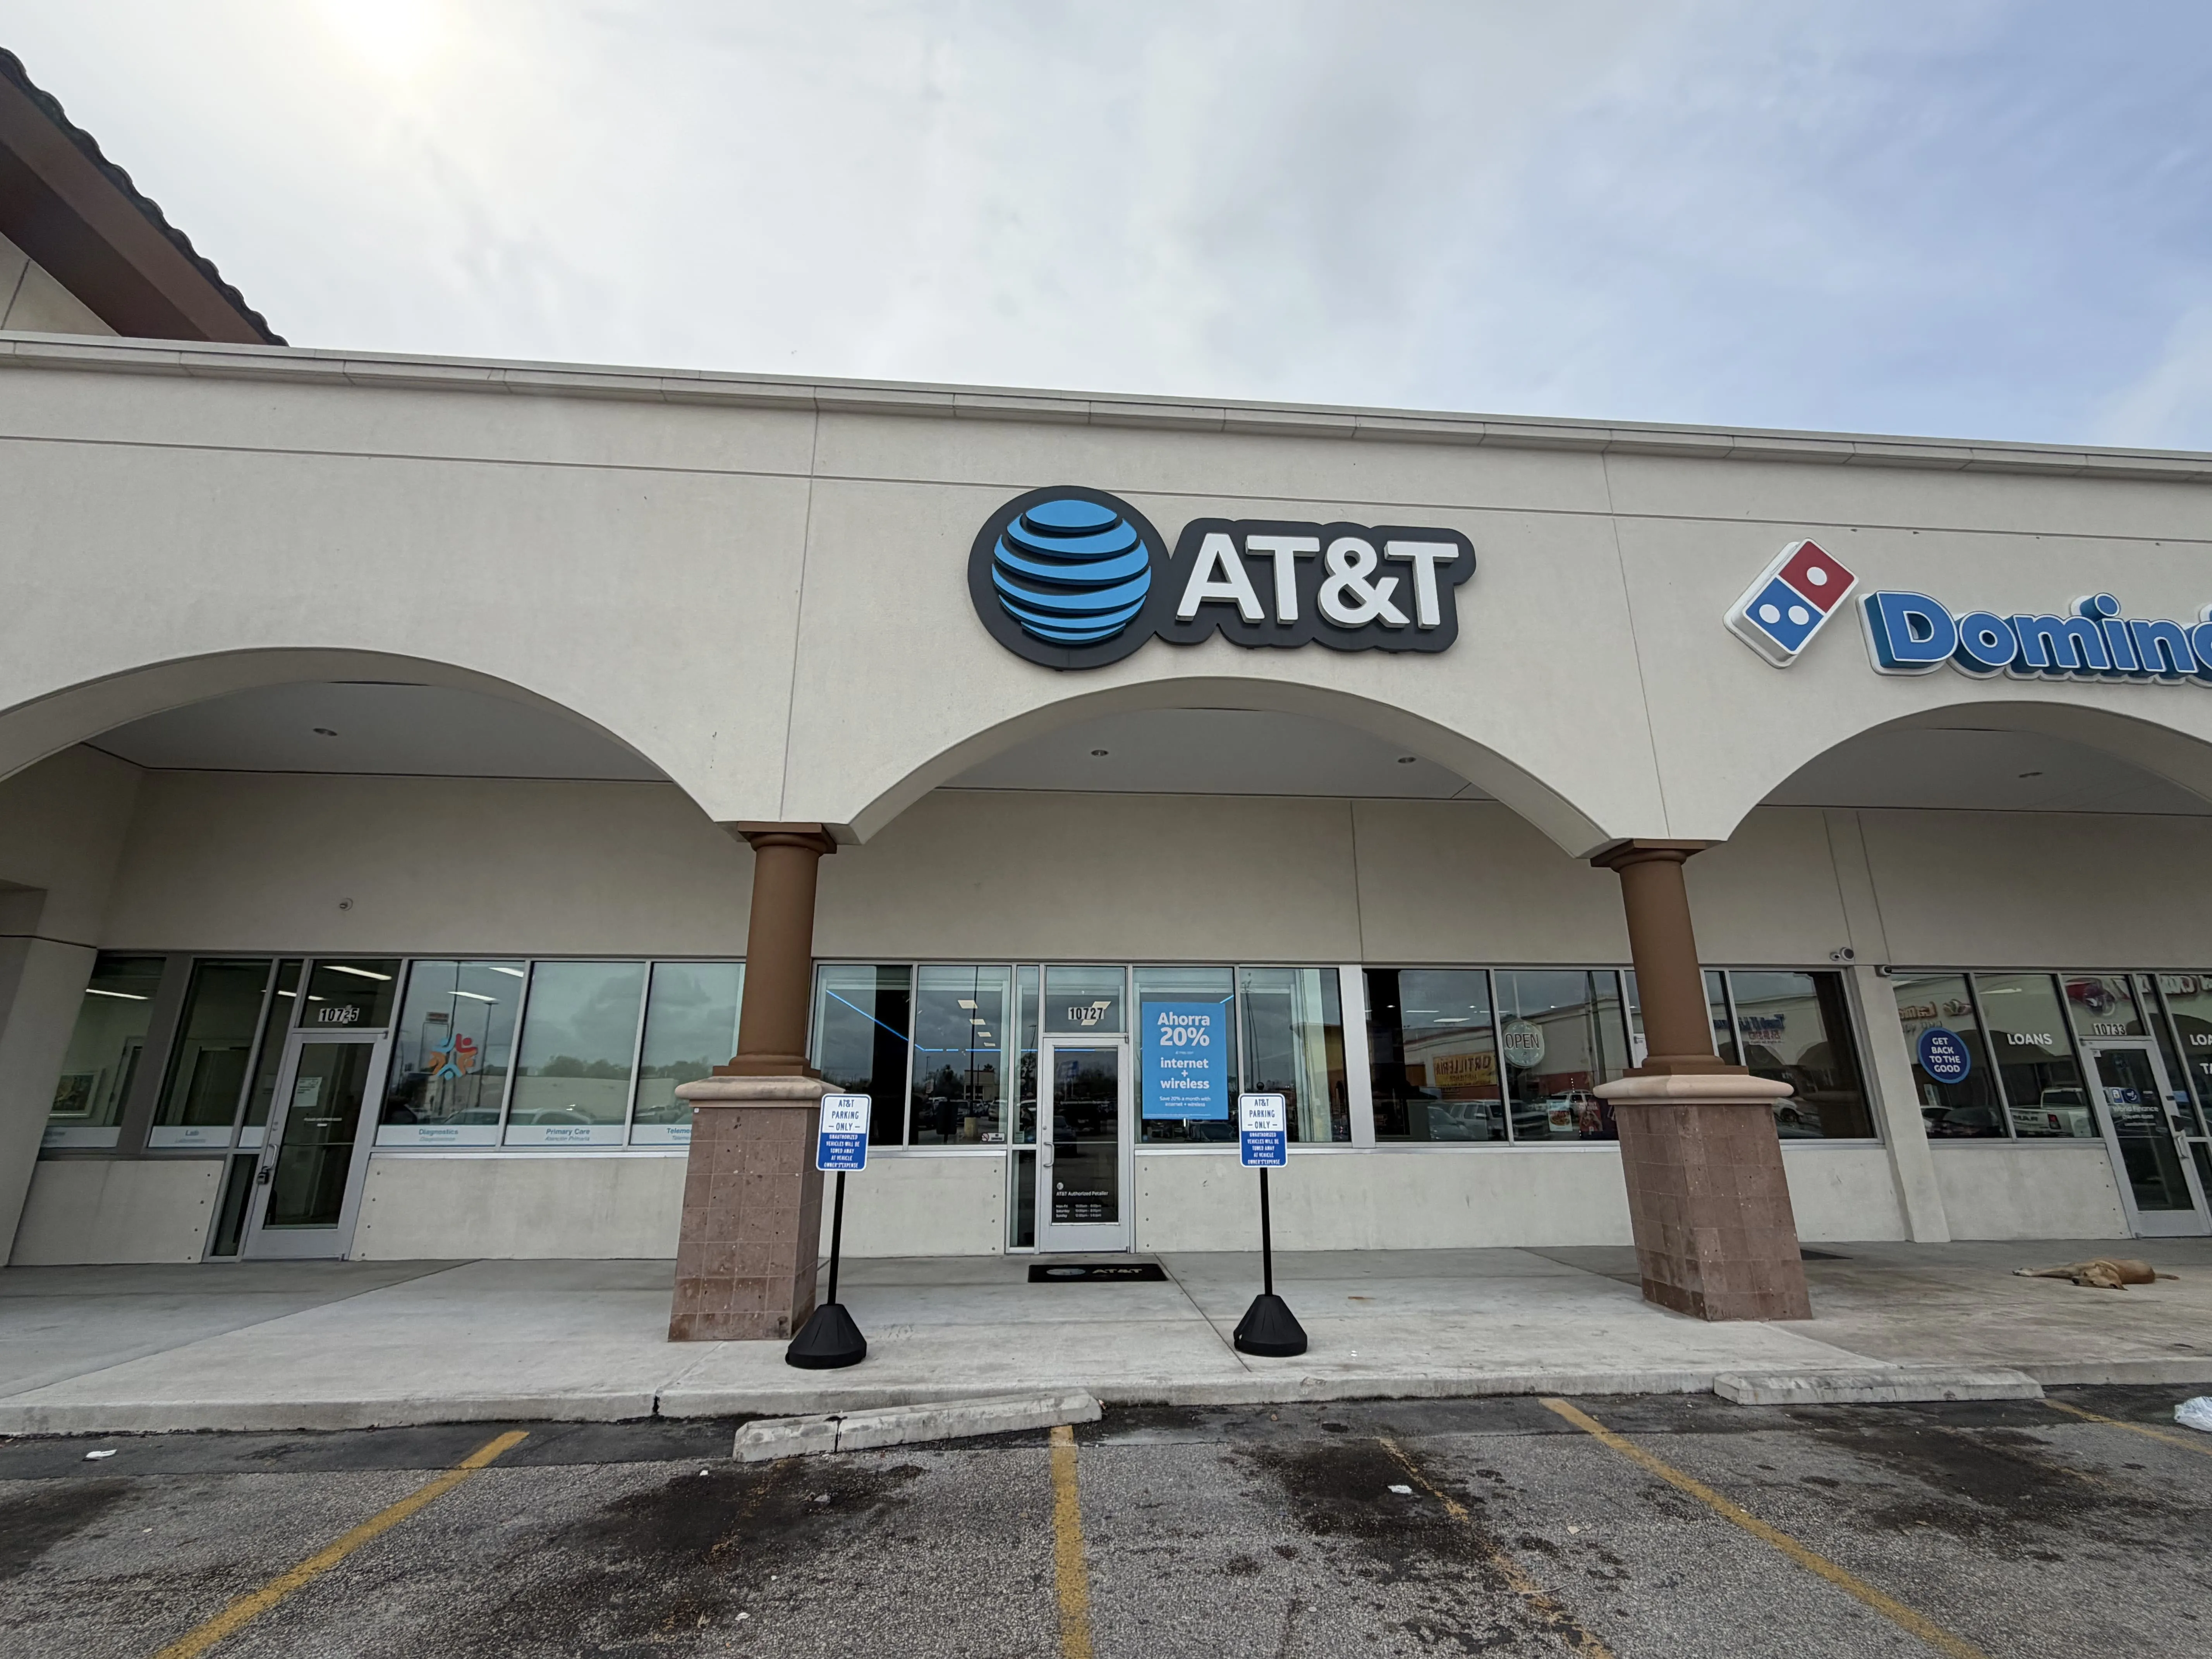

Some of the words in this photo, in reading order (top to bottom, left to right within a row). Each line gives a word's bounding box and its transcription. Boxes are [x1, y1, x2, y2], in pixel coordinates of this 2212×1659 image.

[1175, 532, 1459, 629] AT&T
[322, 1008, 359, 1021] 10725
[1070, 1007, 1103, 1020] 10727
[1157, 1012, 1210, 1026] Ahorra
[2095, 1024, 2126, 1035] 10733
[1160, 1027, 1210, 1046] 20%
[1505, 1033, 1540, 1049] OPEN
[2007, 1033, 2052, 1045] LOANS
[1160, 1057, 1209, 1068] internet
[1160, 1077, 1210, 1089] wireless
[838, 1099, 855, 1108] AT&T
[1254, 1099, 1269, 1107] AT&T
[831, 1111, 859, 1120] PARKING
[1249, 1110, 1275, 1118] PARKING
[836, 1123, 853, 1131] ONLY
